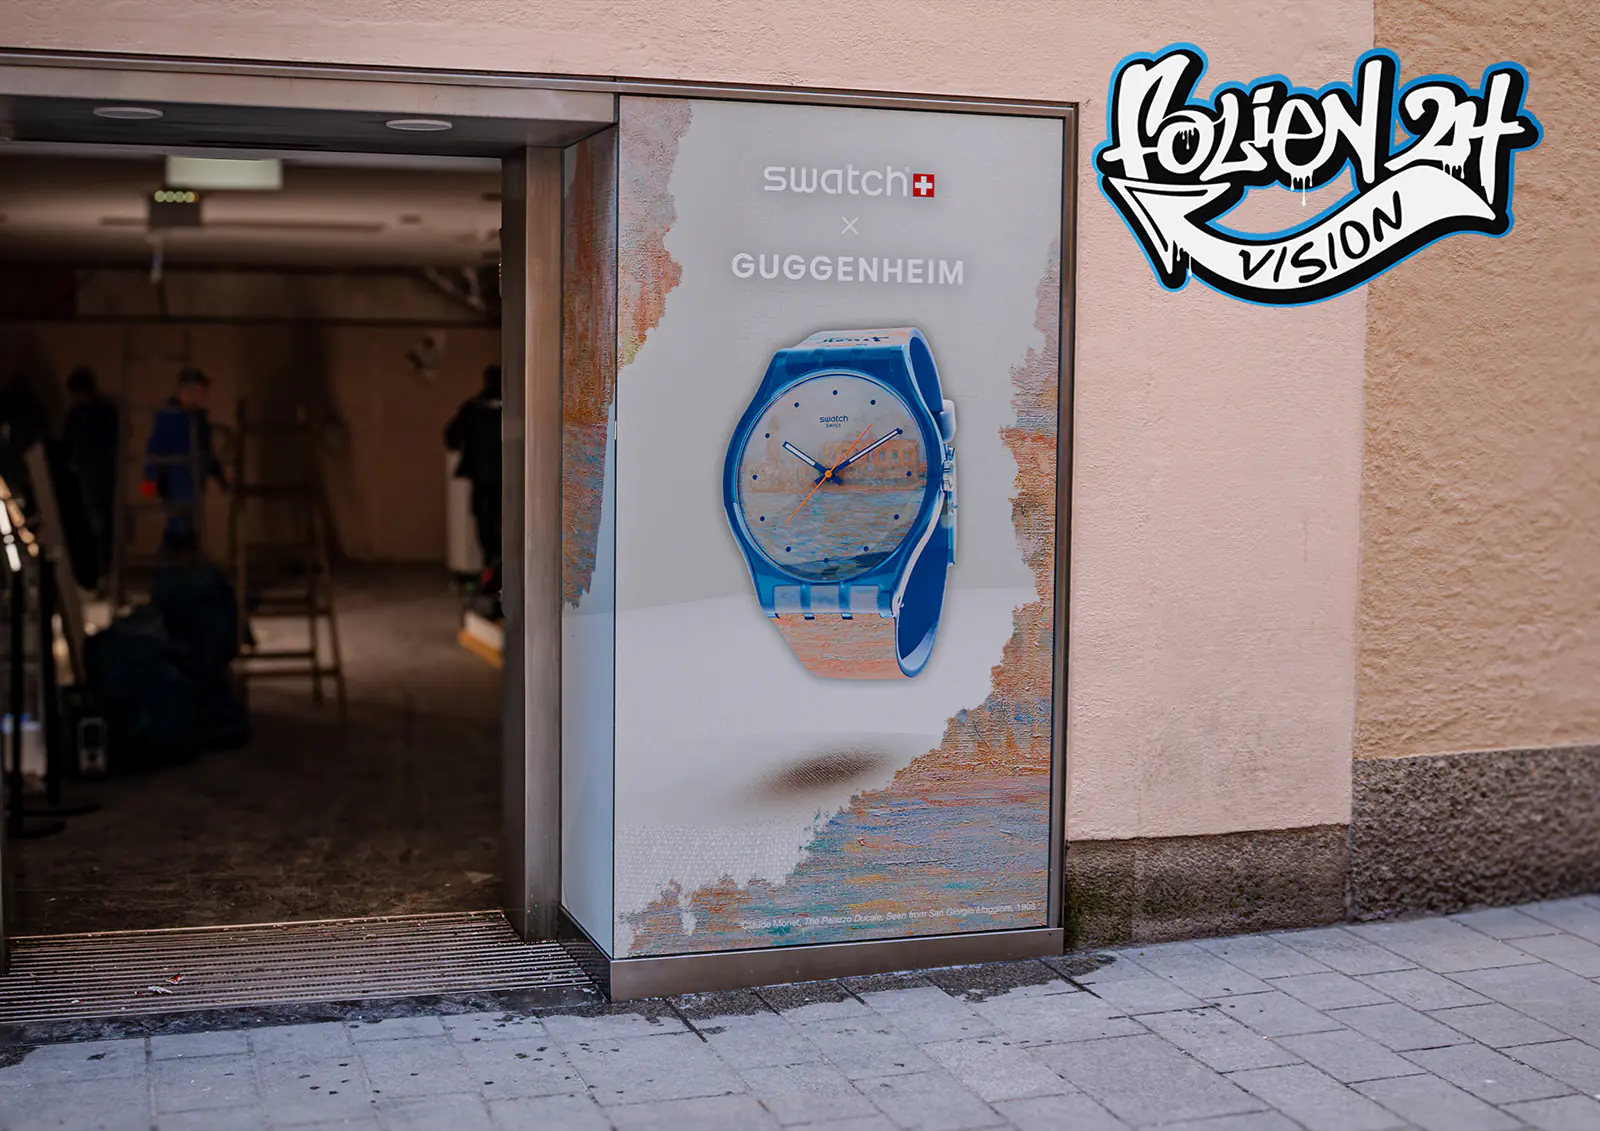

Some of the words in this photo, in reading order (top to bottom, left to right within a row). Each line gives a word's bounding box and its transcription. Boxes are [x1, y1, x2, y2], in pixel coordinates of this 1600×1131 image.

[763, 164, 909, 198] swatch
[731, 253, 964, 285] GUGGENHEIM
[819, 415, 849, 423] swatch
[741, 919, 772, 930] Claude
[803, 917, 820, 926] The
[886, 911, 907, 921] Seen
[908, 910, 927, 919] from
[928, 908, 945, 918] San
